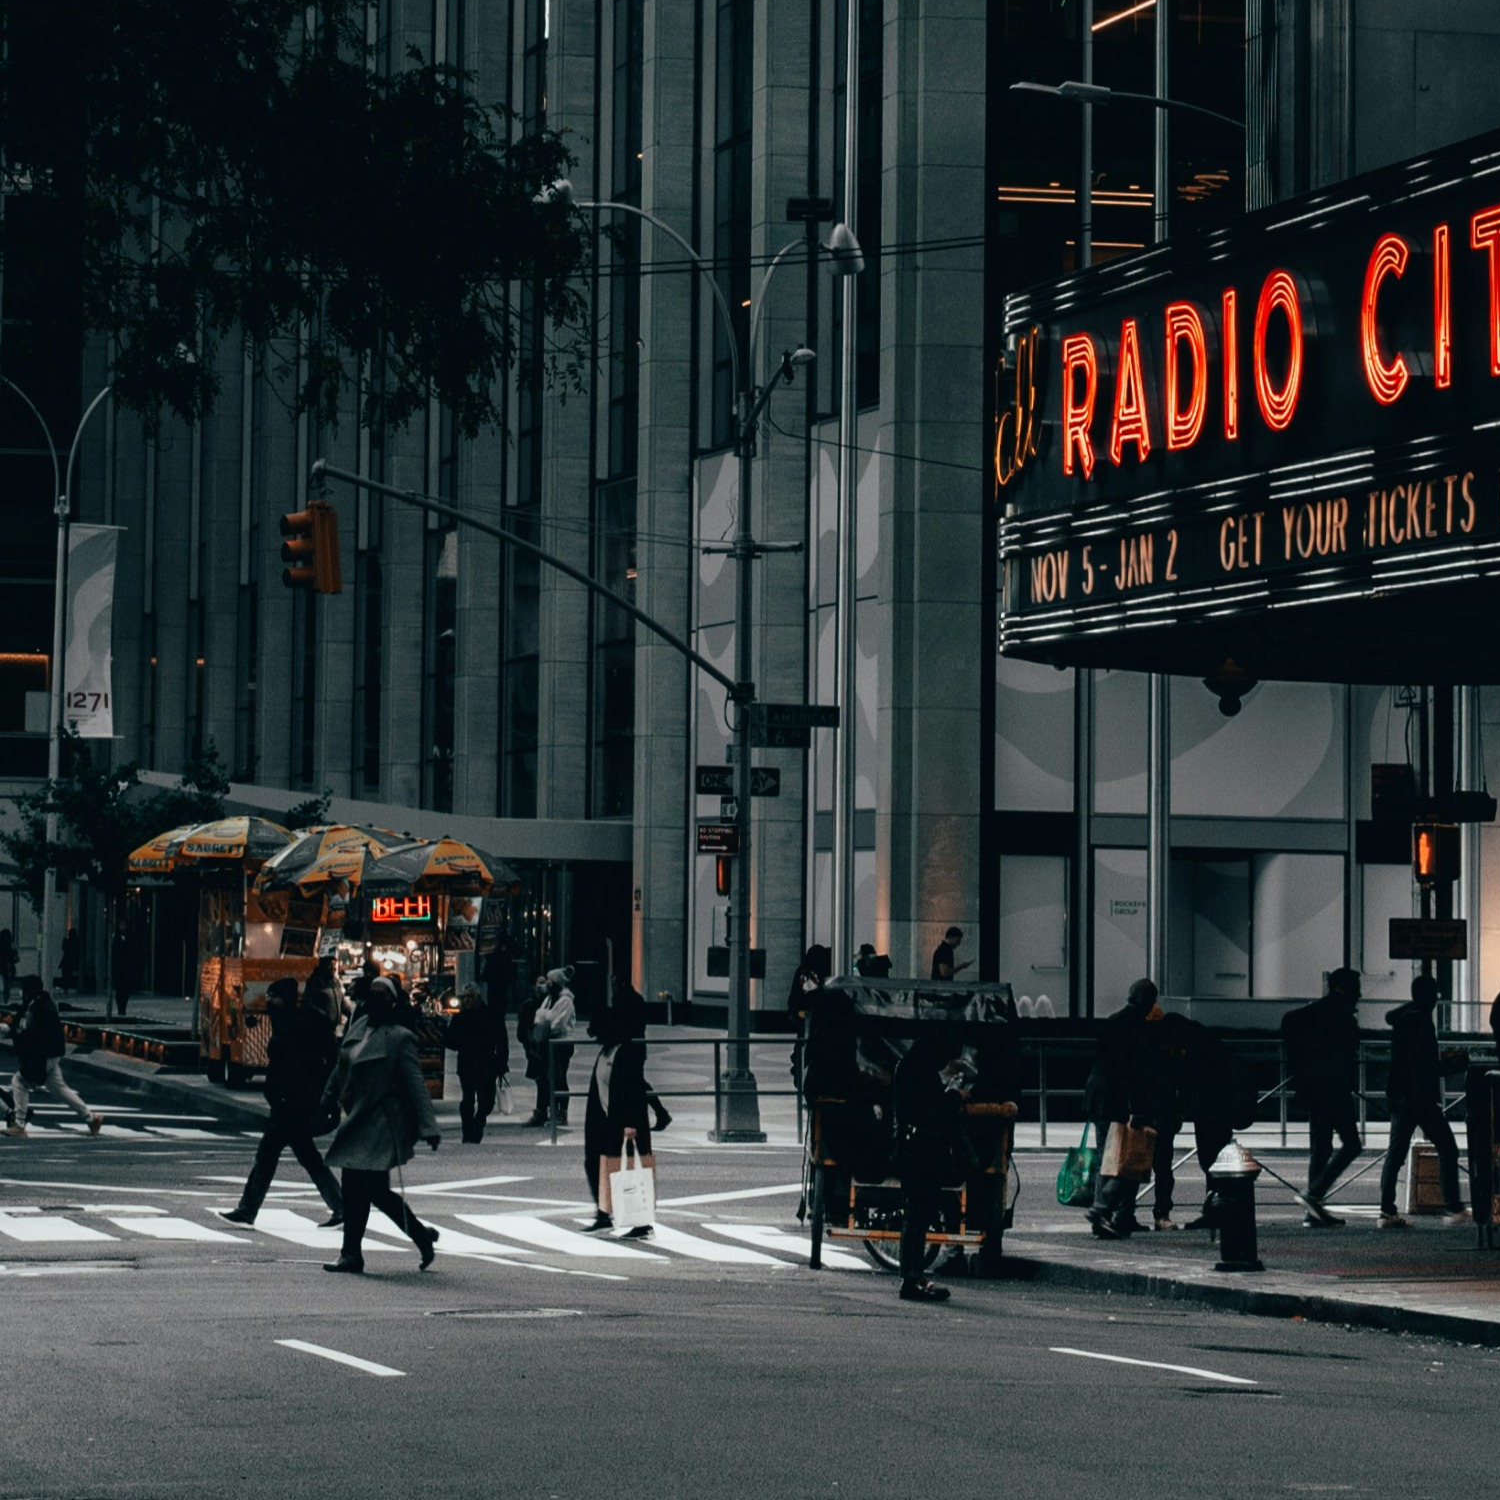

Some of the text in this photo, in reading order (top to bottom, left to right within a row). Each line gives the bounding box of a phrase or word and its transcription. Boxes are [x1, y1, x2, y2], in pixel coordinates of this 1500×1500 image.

[1061, 268, 1304, 481] RADIO
[1031, 549, 1070, 604] NOV
[1165, 528, 1178, 581] 2
[1219, 510, 1265, 572] GET
[1282, 497, 1348, 561] YOUR
[1367, 470, 1477, 548] TICKETS
[67, 692, 108, 712] 1271
[772, 712, 835, 725] AMERICAS
[774, 730, 786, 746] 6
[703, 774, 729, 787] ONE
[186, 843, 241, 853] SABRETT
